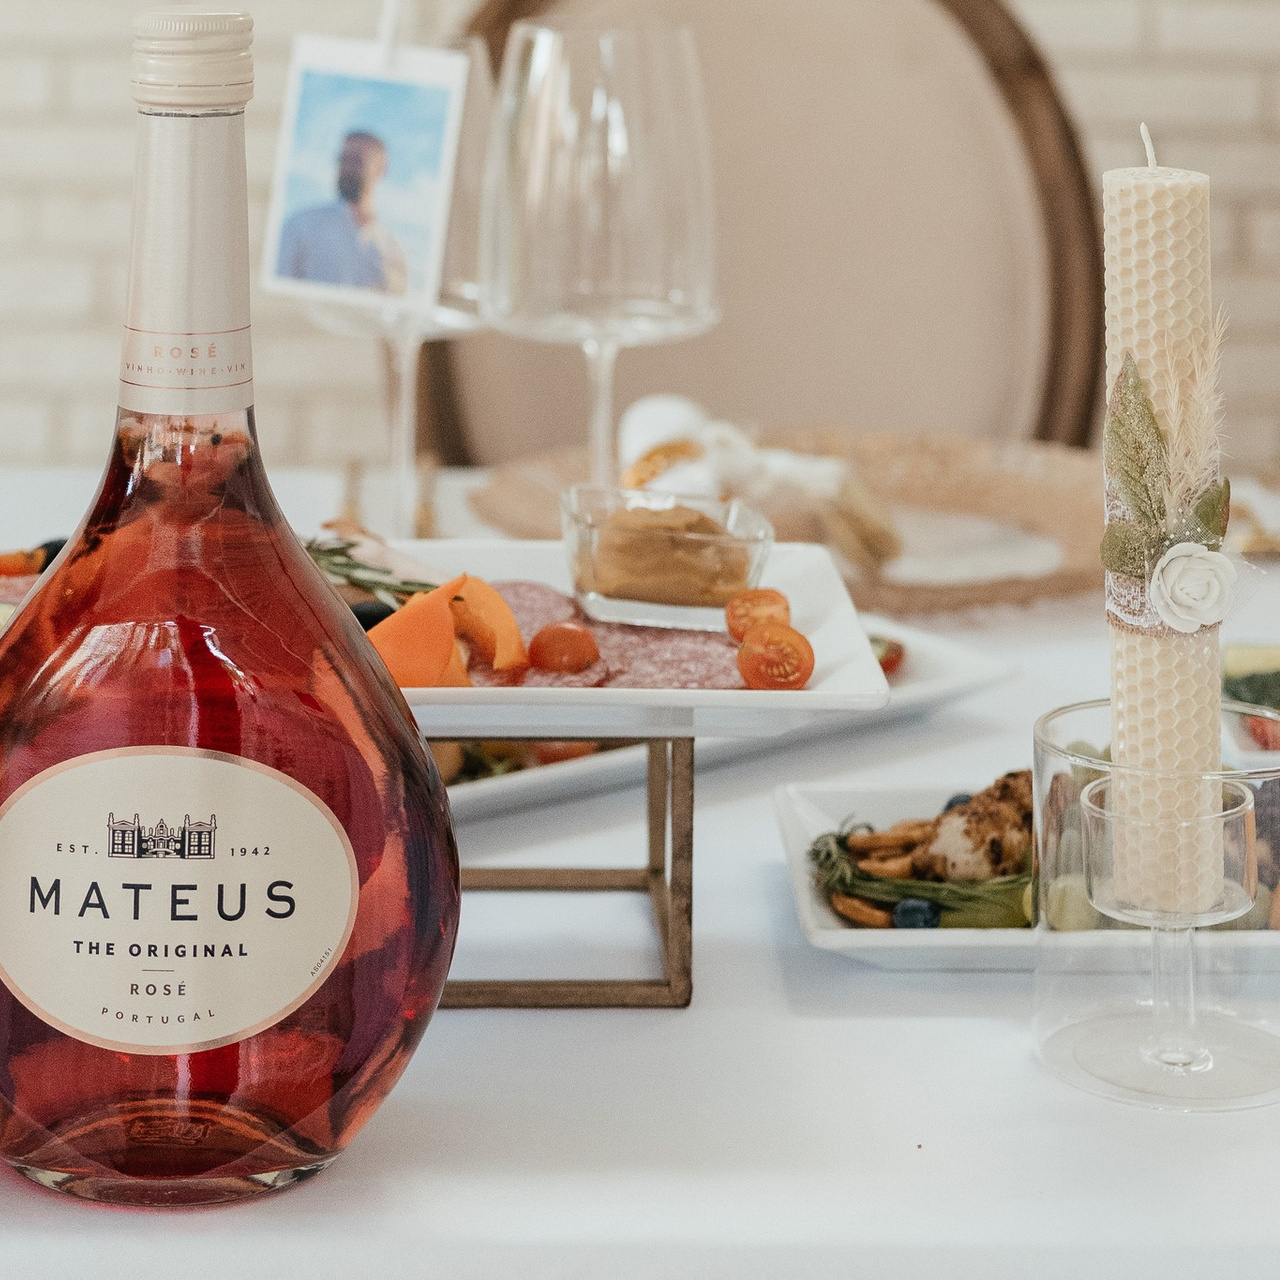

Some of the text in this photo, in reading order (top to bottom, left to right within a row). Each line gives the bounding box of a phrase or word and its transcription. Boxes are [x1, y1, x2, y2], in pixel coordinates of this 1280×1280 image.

[154, 343, 216, 359] ROSÉ
[56, 843, 270, 857] EST. 1942
[29, 876, 296, 922] MATEUS
[73, 940, 248, 958] THE ORIGINAL
[130, 980, 186, 996] ROSÉ
[101, 1007, 215, 1025] PORTUGAL
